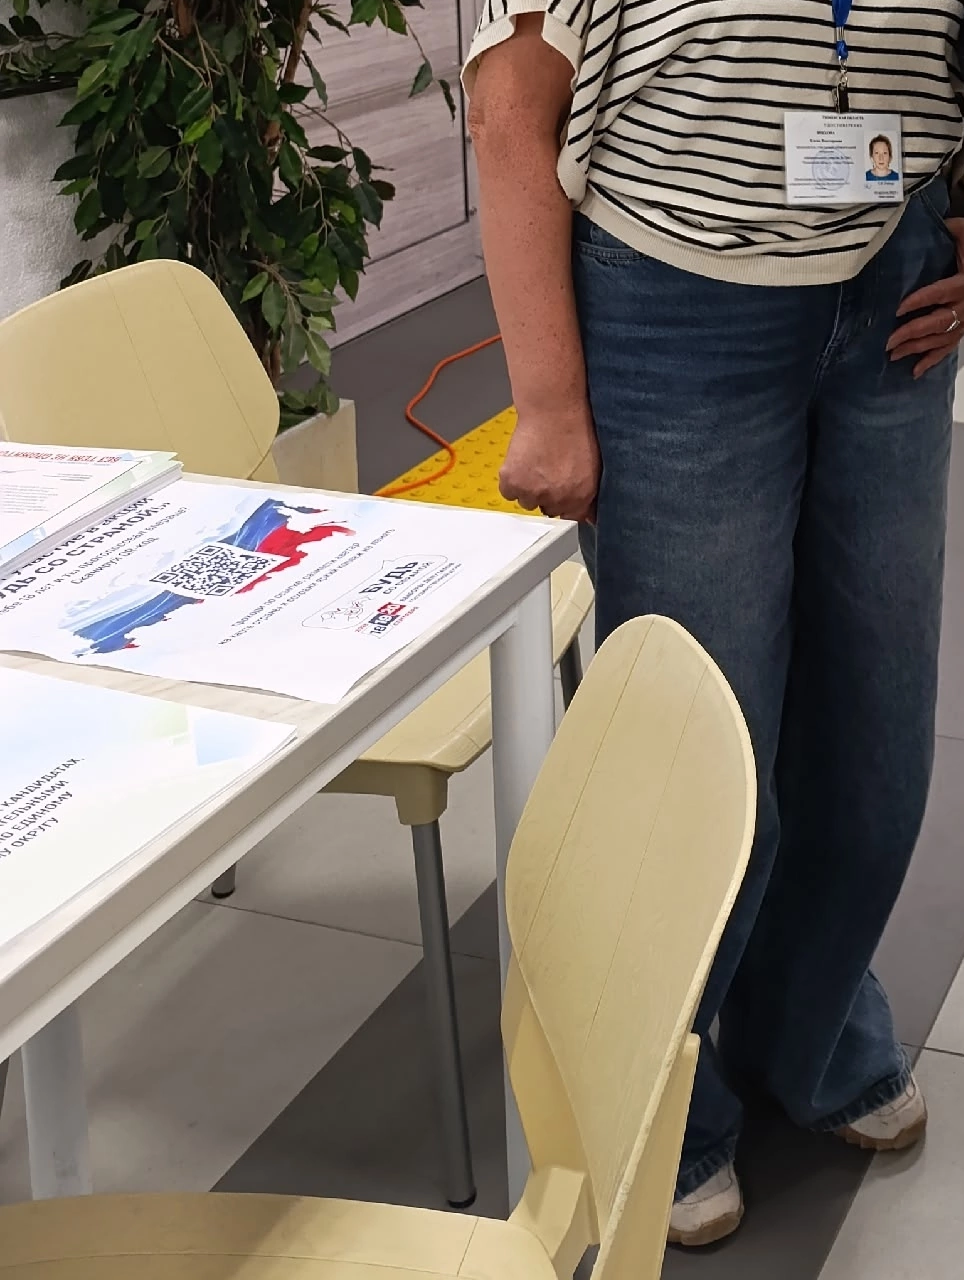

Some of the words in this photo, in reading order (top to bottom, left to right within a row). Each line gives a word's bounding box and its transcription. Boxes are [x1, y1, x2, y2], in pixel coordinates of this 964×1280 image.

[102, 497, 154, 526] акции
[34, 558, 68, 574] СО
[358, 562, 418, 594] БУДЬ
[11, 791, 73, 831] ЕДИНОМУ
[11, 817, 58, 847] ОКРУГУ
